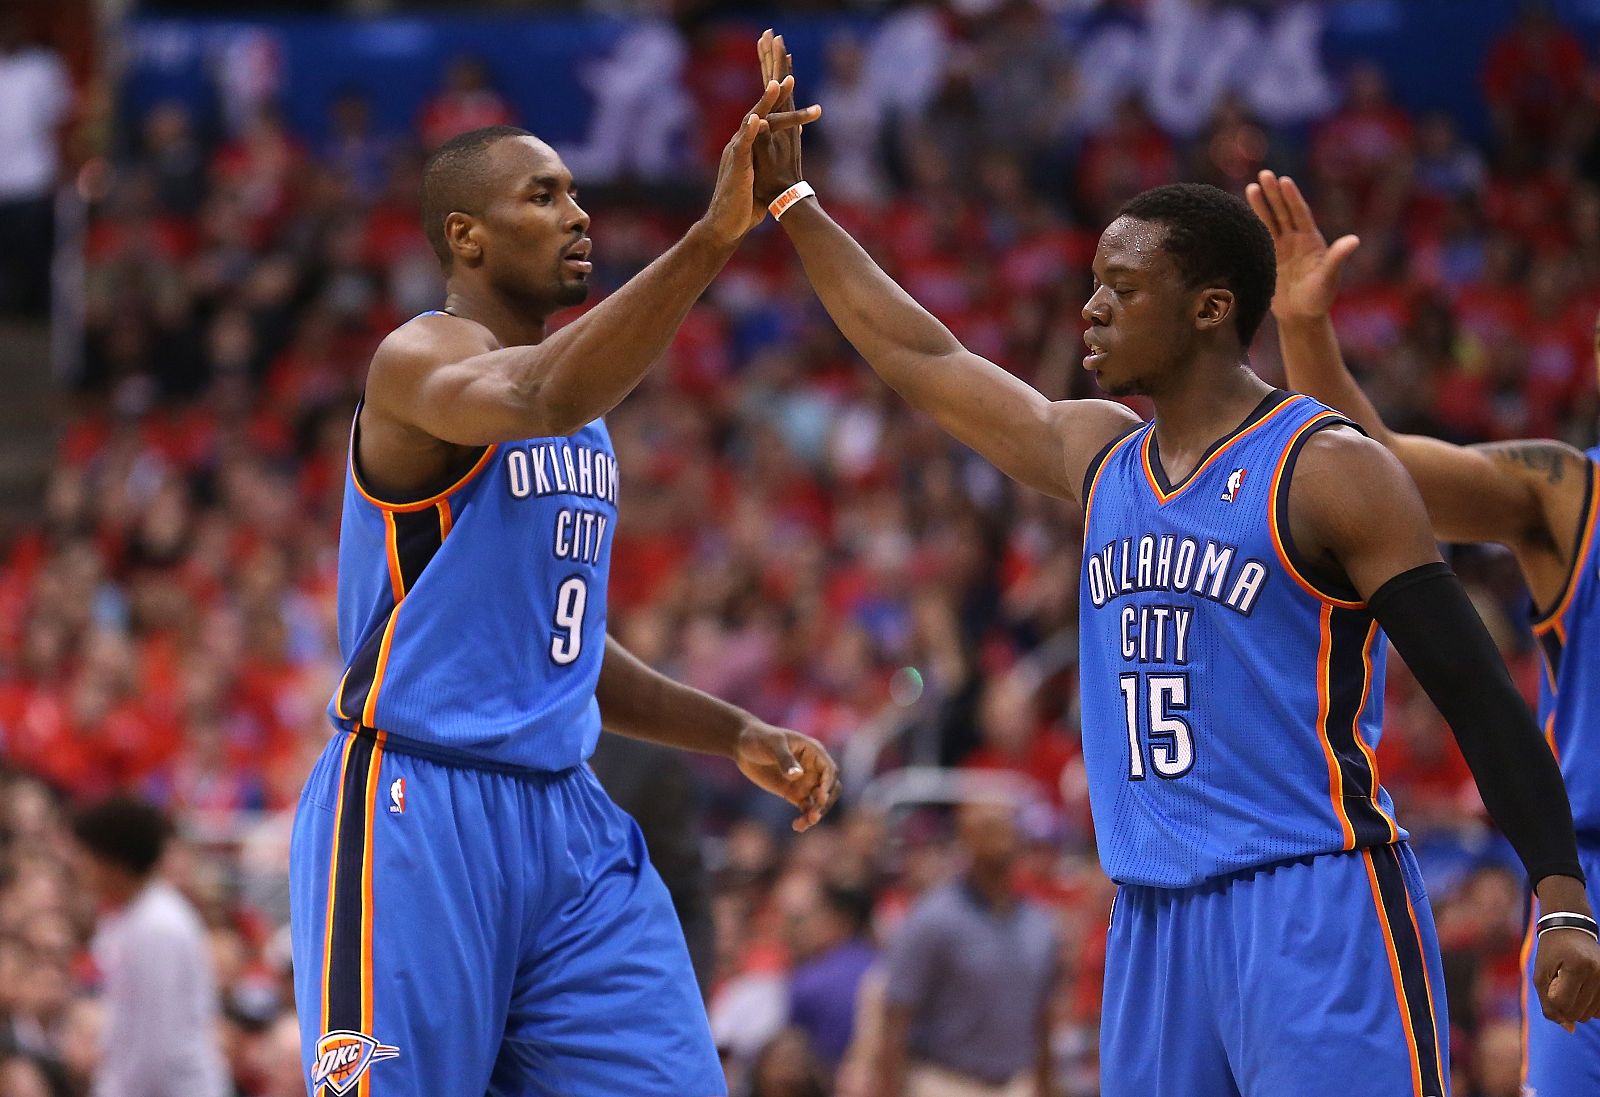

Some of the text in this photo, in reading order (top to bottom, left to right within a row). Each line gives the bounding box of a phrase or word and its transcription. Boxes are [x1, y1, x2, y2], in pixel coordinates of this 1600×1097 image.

[506, 441, 620, 506] OKLAHOM
[553, 507, 608, 566] CITY
[1088, 532, 1270, 617] OKLAHOMA
[550, 573, 588, 666] 9
[1121, 603, 1194, 665] CITY
[1119, 671, 1196, 781] 15
[315, 1043, 361, 1085] OKC
